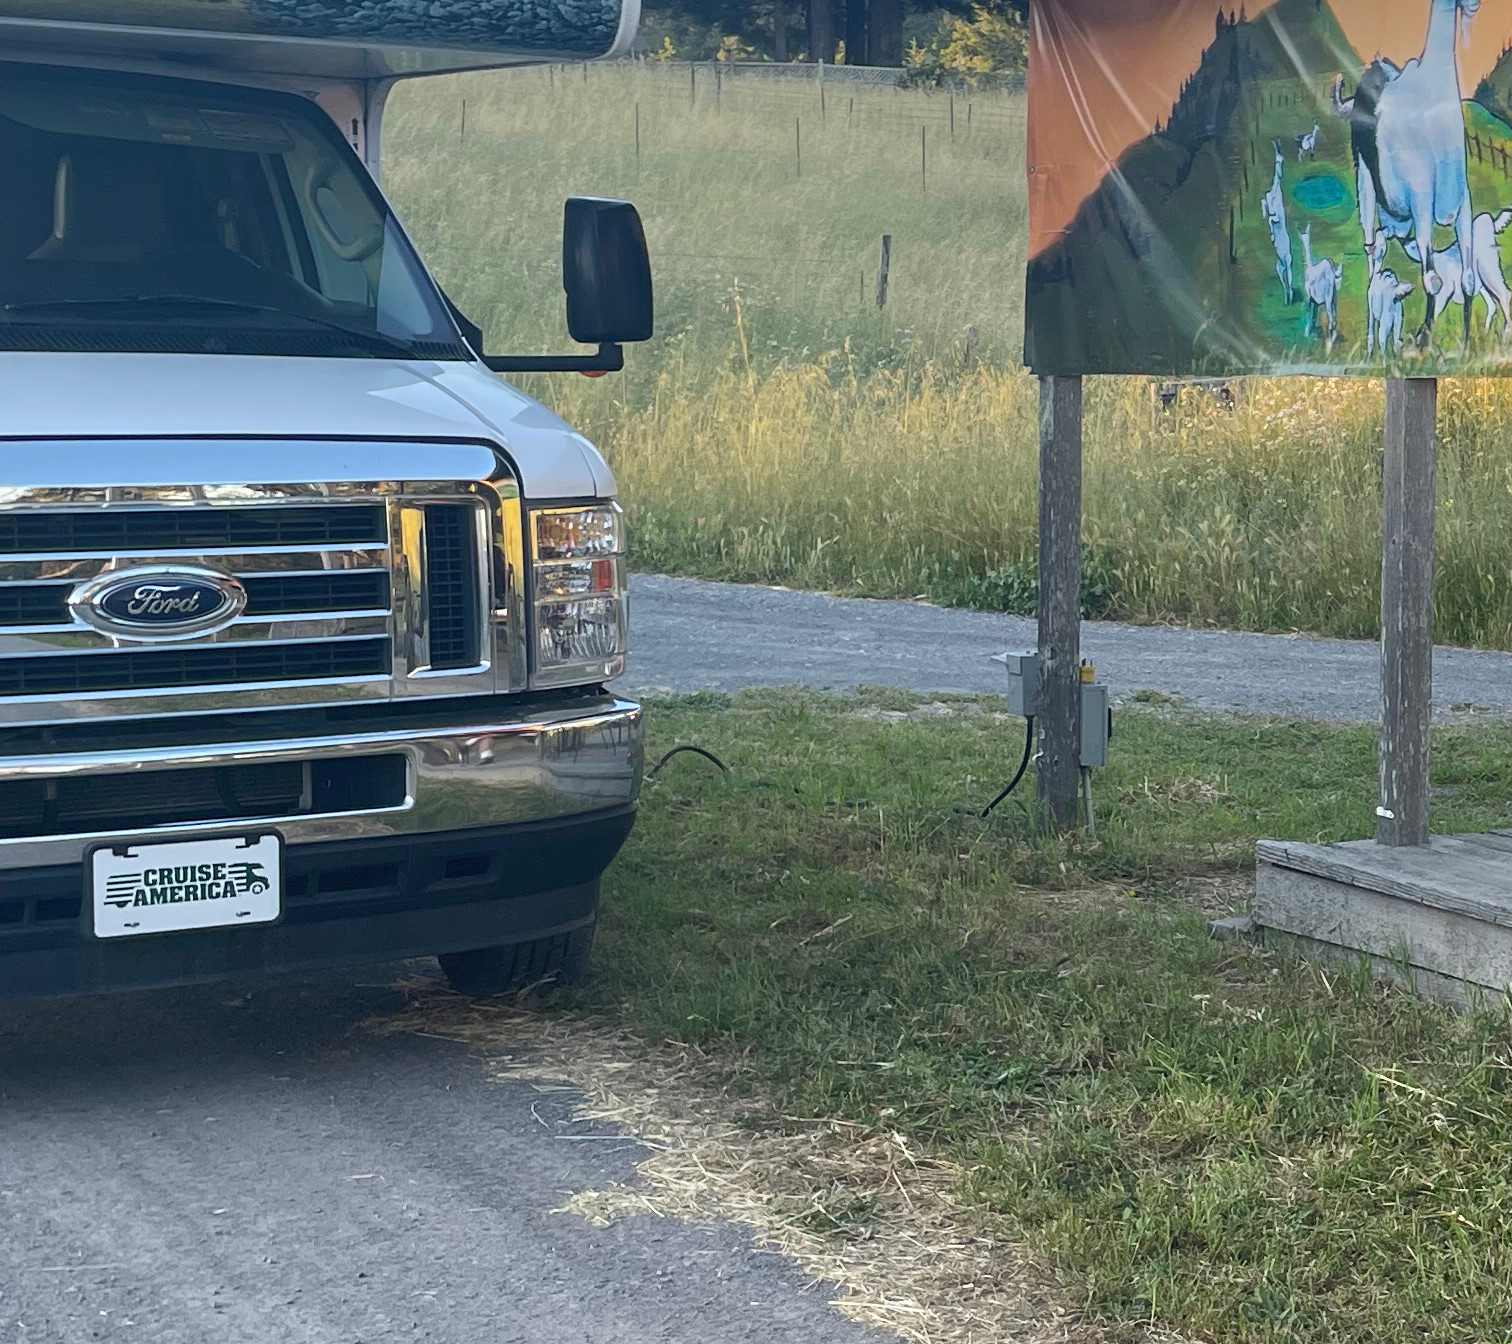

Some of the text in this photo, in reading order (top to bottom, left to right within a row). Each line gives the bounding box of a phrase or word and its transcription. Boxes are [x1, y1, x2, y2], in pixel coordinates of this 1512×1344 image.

[127, 585, 201, 615] Ford
[143, 862, 227, 887] CRUISE
[133, 880, 237, 907] AMERICA
